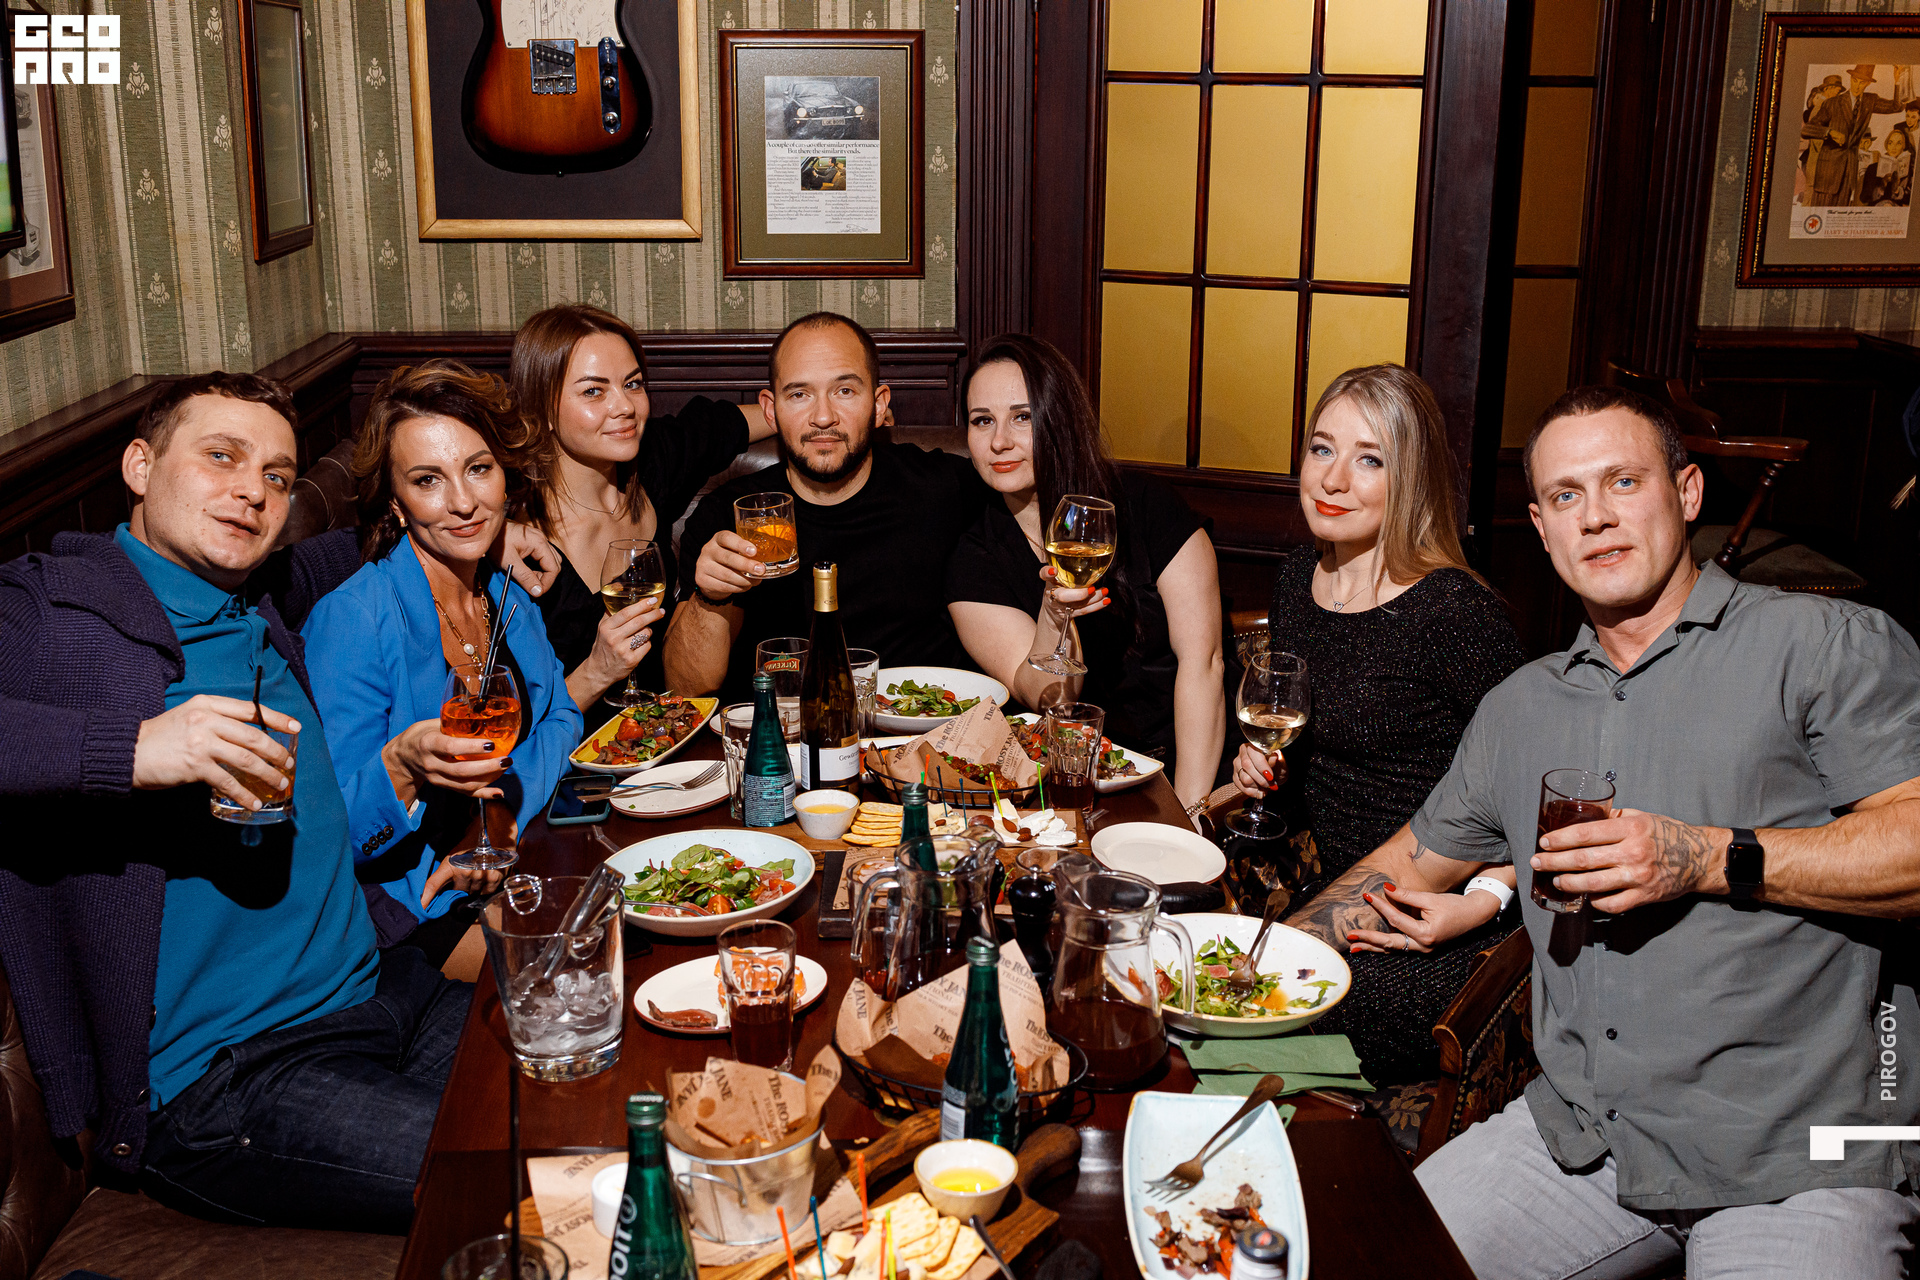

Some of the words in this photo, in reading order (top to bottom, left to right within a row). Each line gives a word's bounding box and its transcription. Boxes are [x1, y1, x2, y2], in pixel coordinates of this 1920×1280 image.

[943, 716, 958, 735] ROS
[1012, 961, 1035, 981] ROS
[853, 987, 867, 1019] JANE
[932, 1024, 954, 1043] The
[709, 1067, 733, 1101] JANE
[768, 1074, 783, 1101] The
